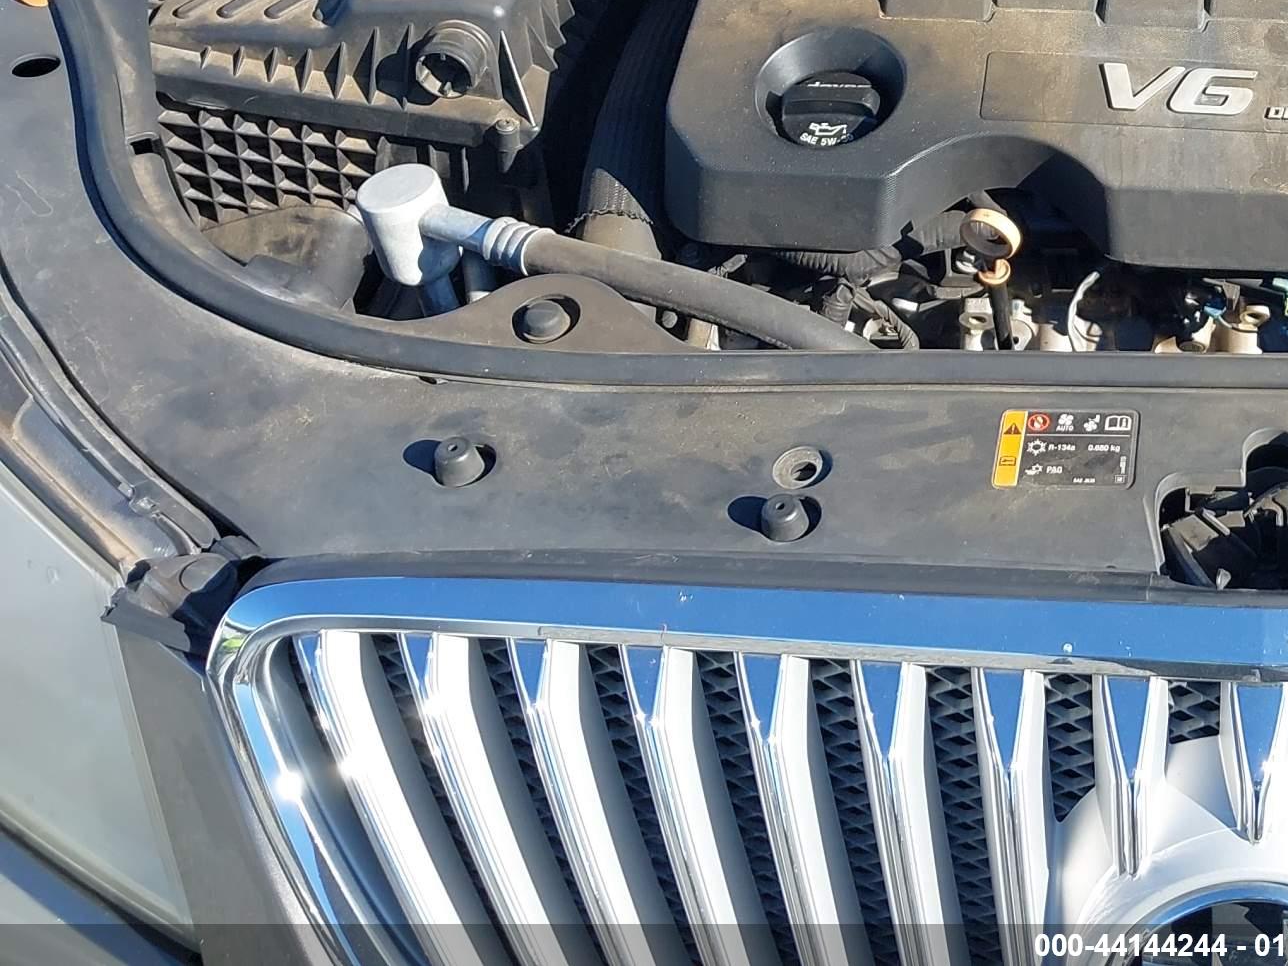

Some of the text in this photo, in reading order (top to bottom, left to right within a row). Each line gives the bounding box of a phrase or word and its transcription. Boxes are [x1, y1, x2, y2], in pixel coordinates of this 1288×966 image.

[1099, 62, 1259, 115] V6
[800, 132, 818, 145] SAE
[1110, 444, 1121, 453] kg
